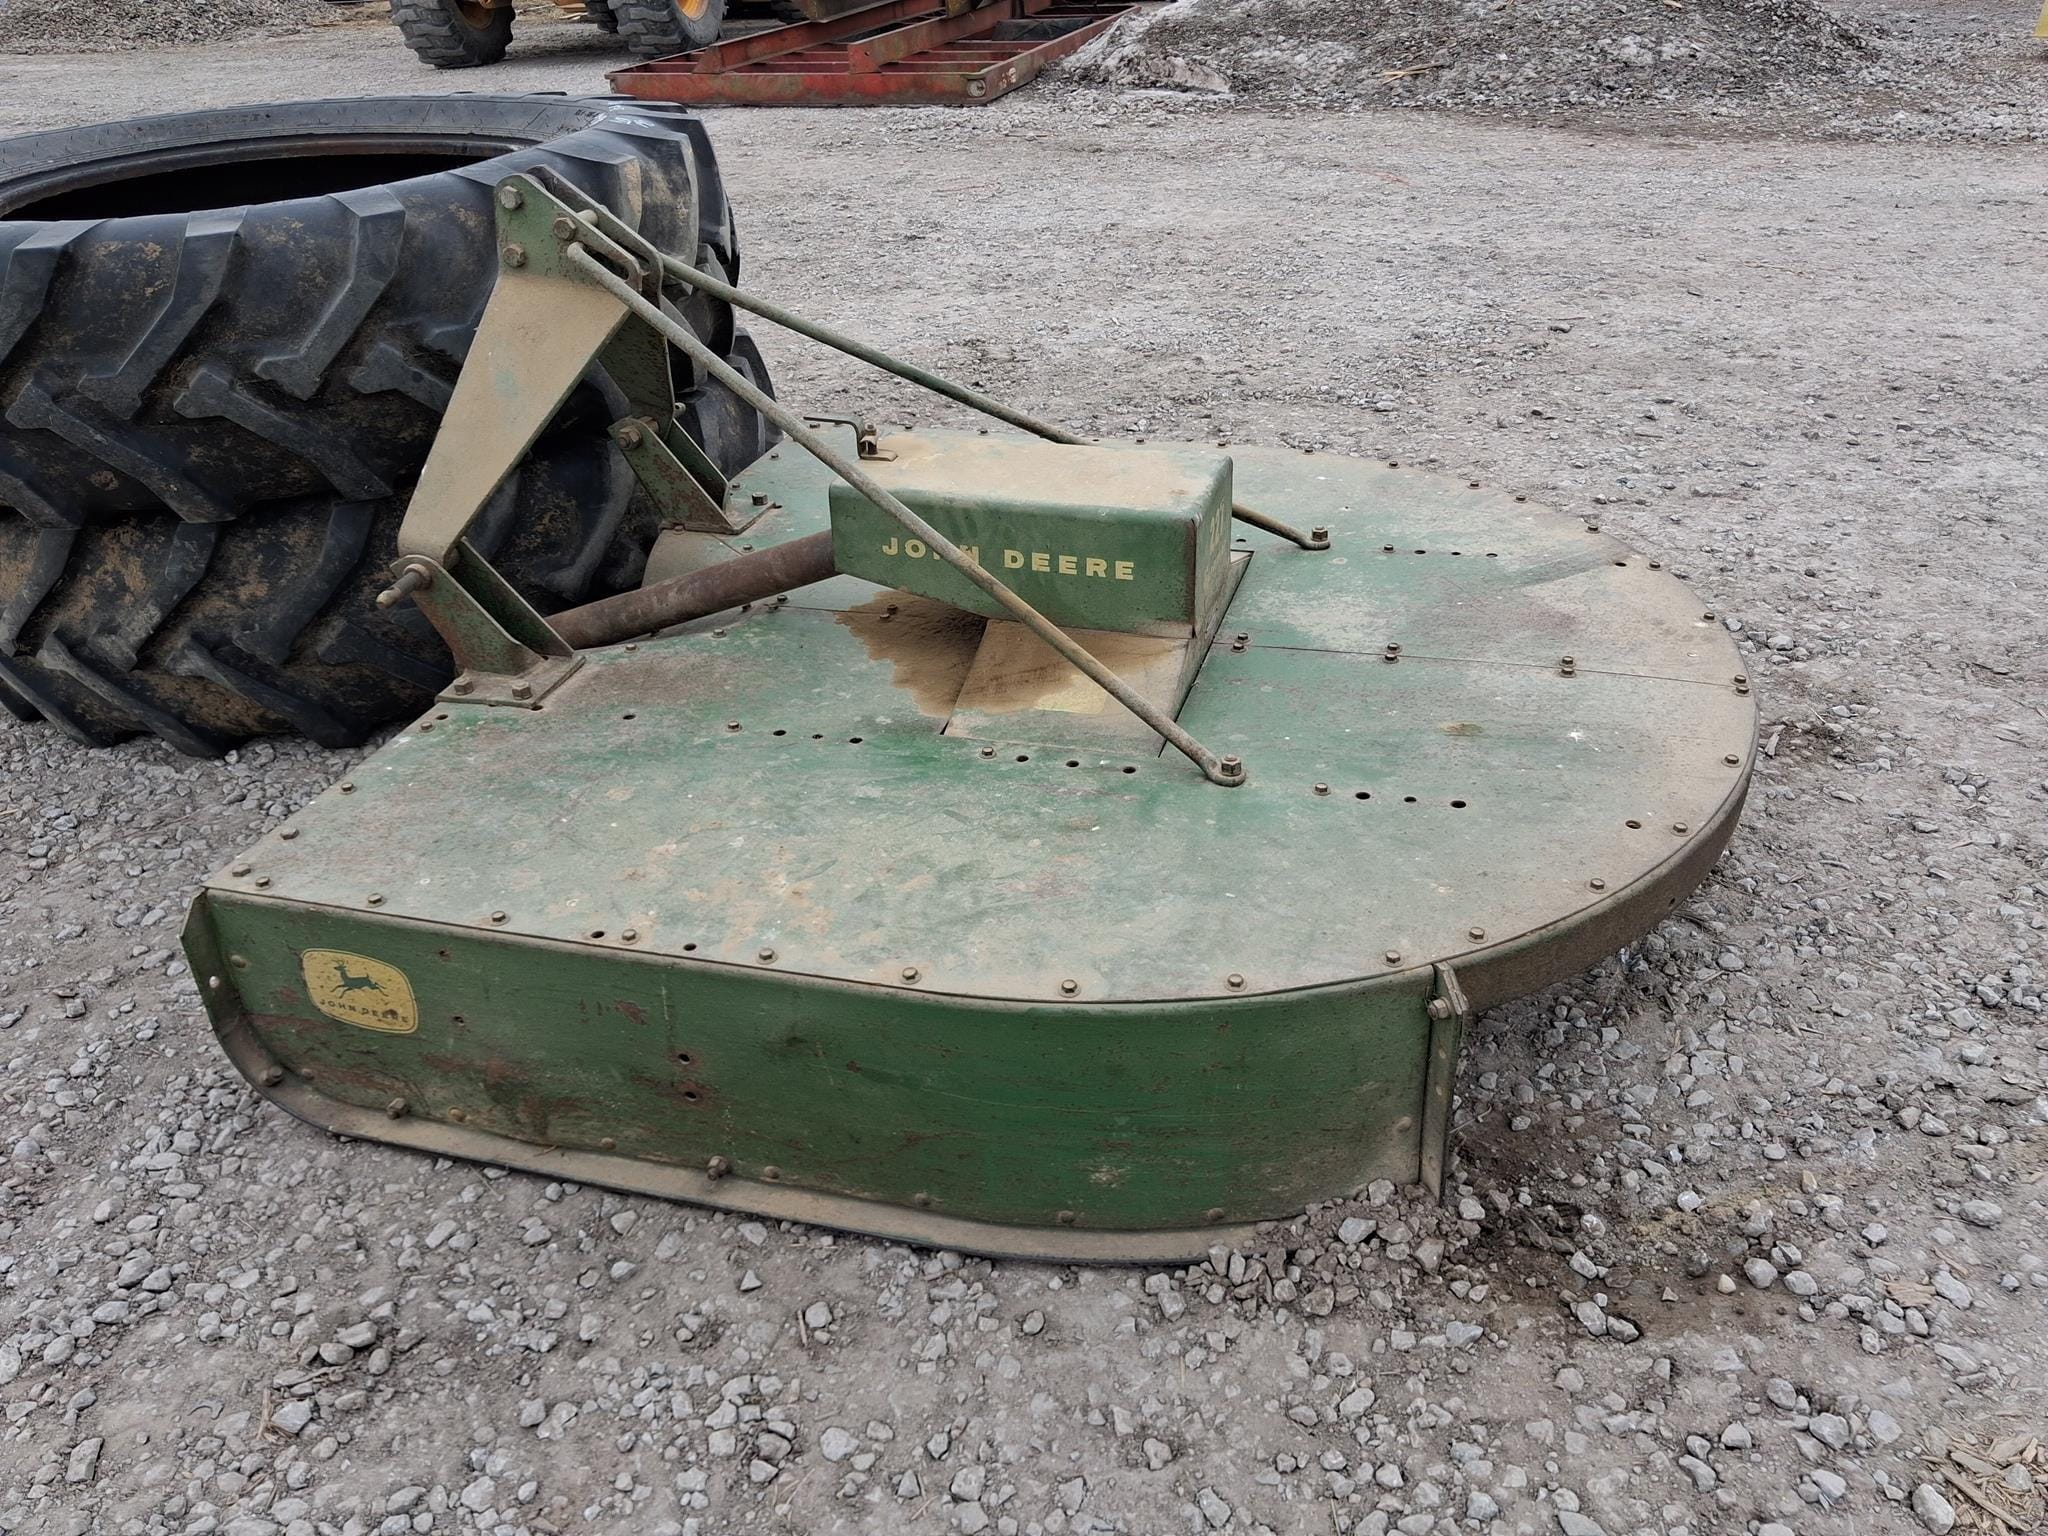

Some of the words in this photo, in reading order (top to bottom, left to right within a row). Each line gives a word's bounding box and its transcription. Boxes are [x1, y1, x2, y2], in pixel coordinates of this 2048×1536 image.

[882, 537, 980, 566] JON
[1004, 549, 1135, 581] DEERE
[320, 1000, 357, 1012] JOHN
